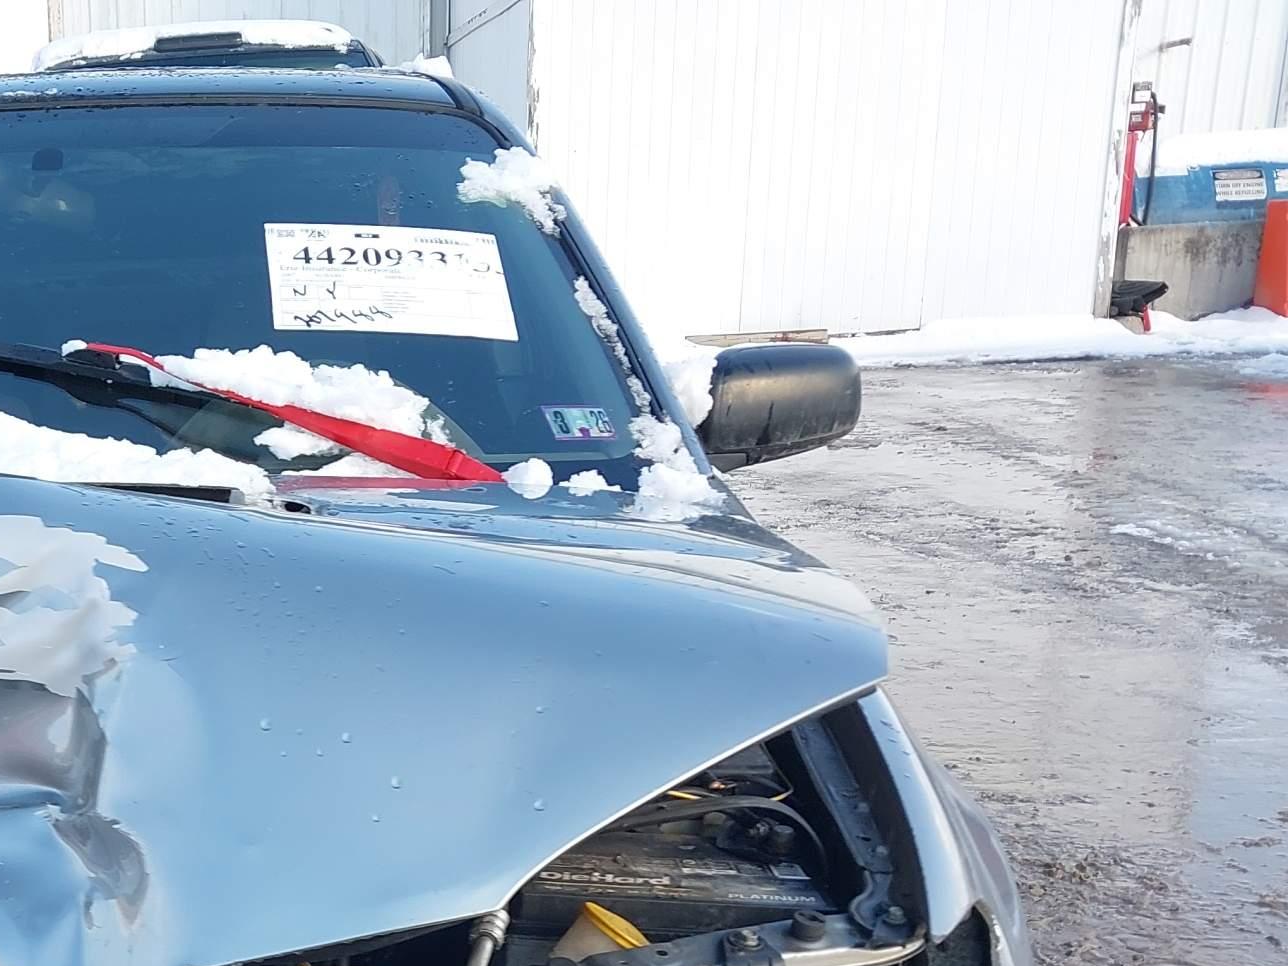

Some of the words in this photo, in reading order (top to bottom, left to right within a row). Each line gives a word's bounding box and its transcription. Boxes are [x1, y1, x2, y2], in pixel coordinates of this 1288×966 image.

[552, 410, 570, 434] 3
[589, 410, 613, 434] 26
[539, 871, 671, 885] DieHard
[727, 893, 816, 902] PLATINUM
